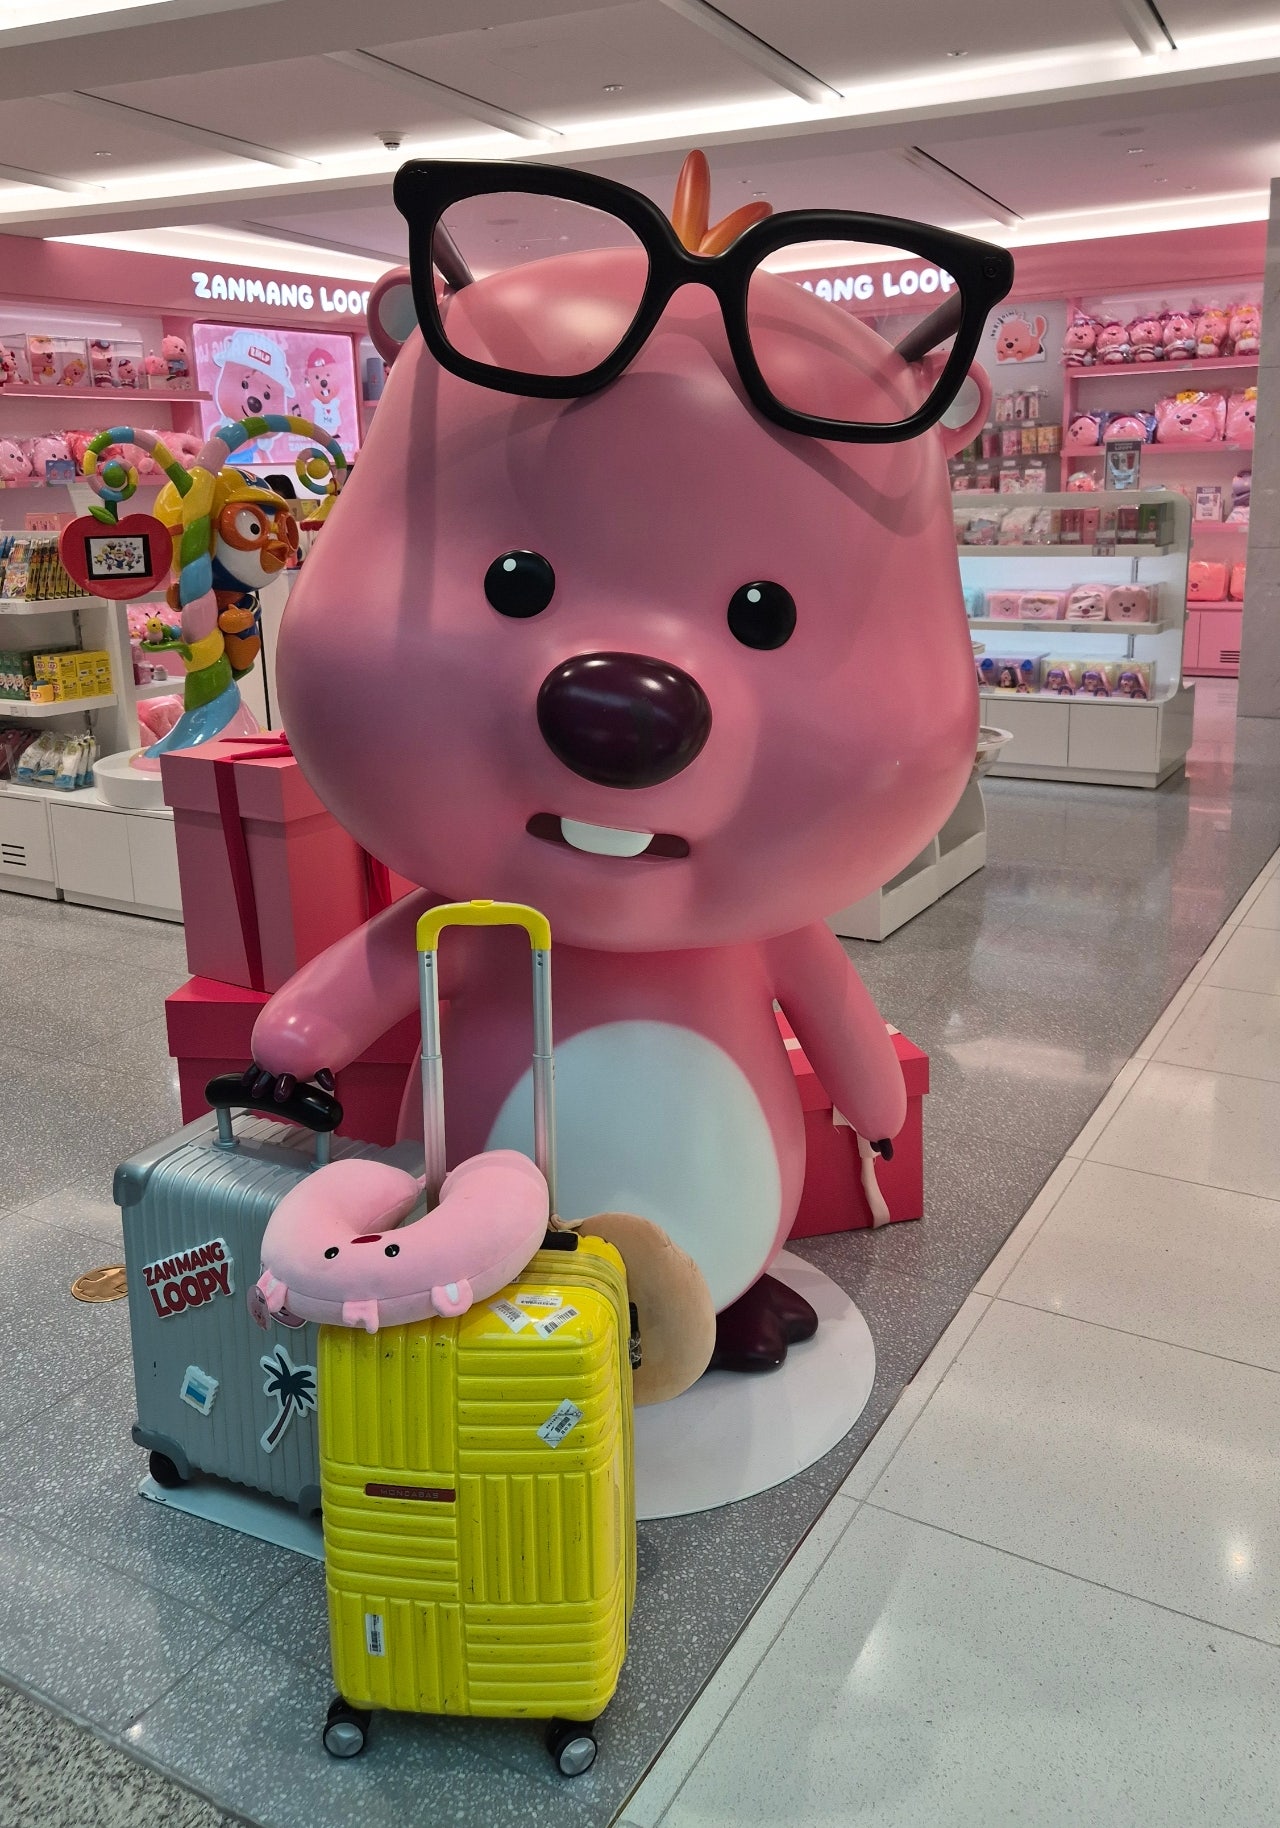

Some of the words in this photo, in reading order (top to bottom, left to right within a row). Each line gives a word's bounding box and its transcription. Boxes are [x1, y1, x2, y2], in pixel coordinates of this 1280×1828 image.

[191, 271, 314, 310] ZANMANG
[795, 274, 875, 303] ANG
[142, 1241, 226, 1287] ZANMANG
[150, 1262, 232, 1318] LOOPY
